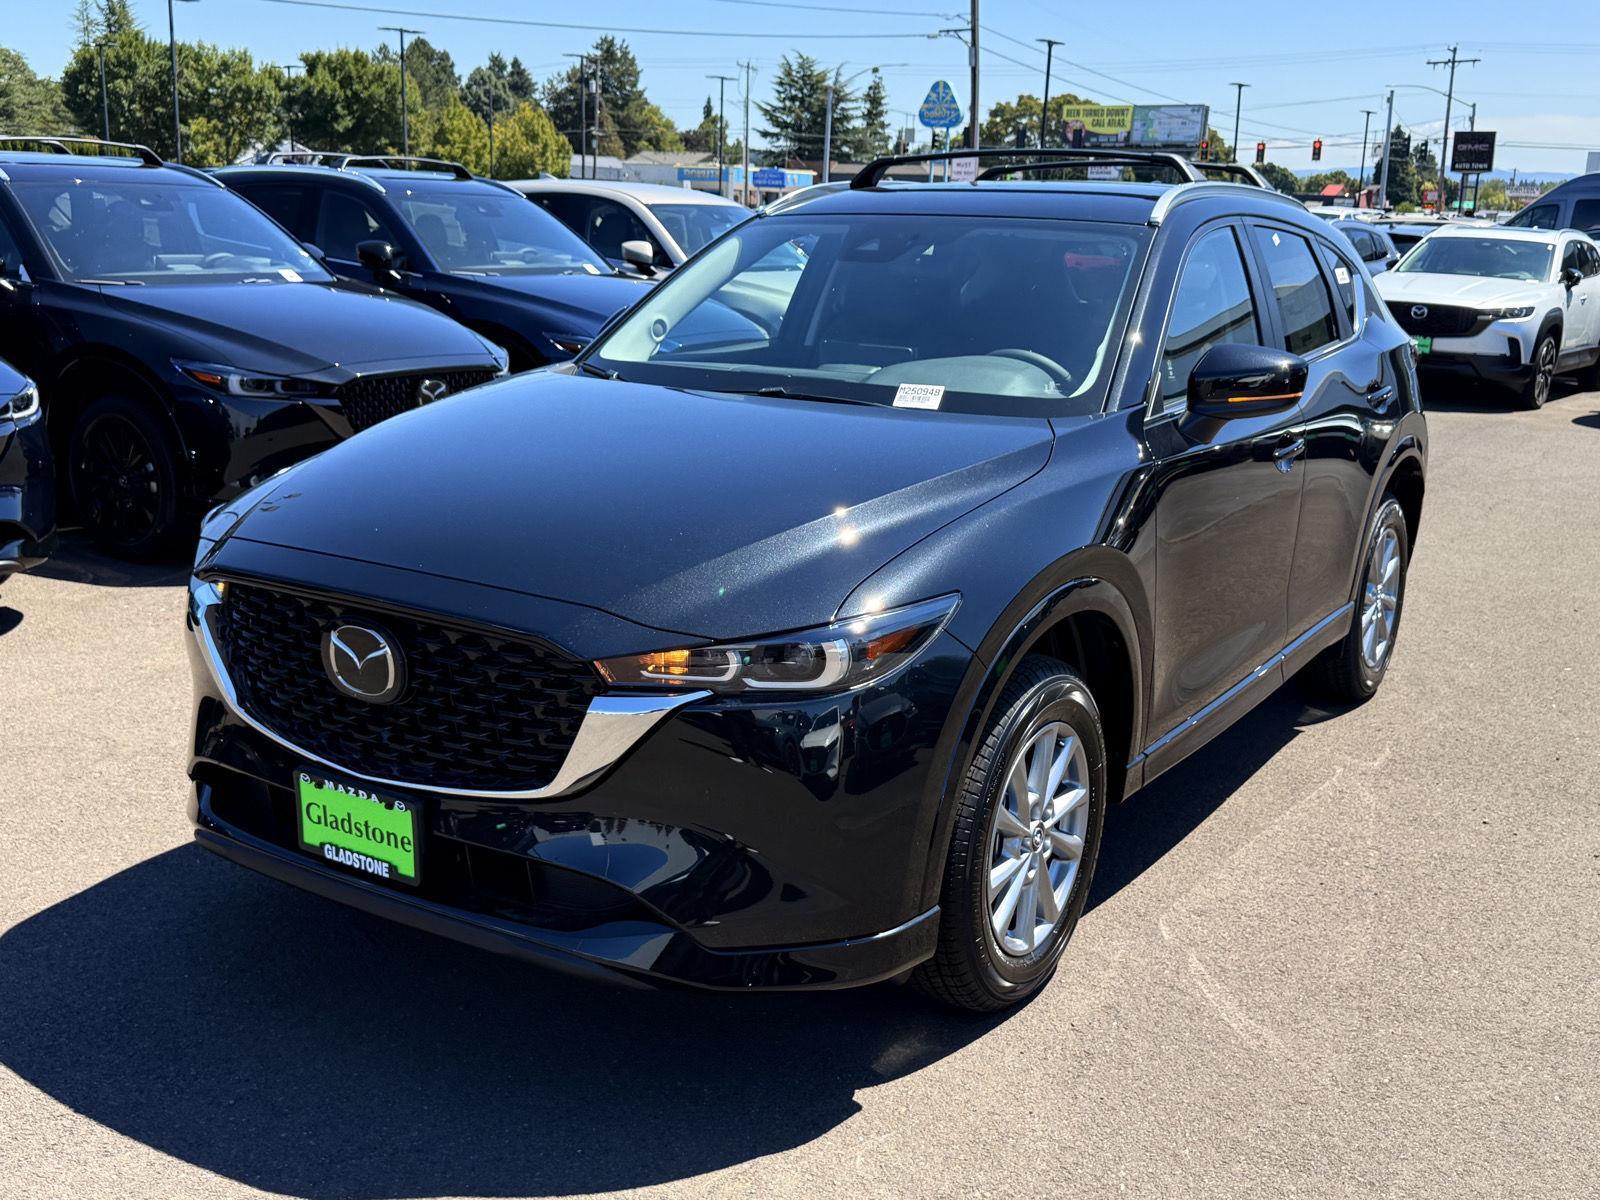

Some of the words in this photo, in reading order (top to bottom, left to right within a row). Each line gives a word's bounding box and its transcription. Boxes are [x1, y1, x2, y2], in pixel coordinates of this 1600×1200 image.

[1091, 118, 1105, 128] CALL
[1457, 143, 1490, 152] GMC
[324, 780, 380, 804] MAZDA
[305, 802, 412, 853] Gladstone
[324, 843, 390, 878] GLADSTONE
